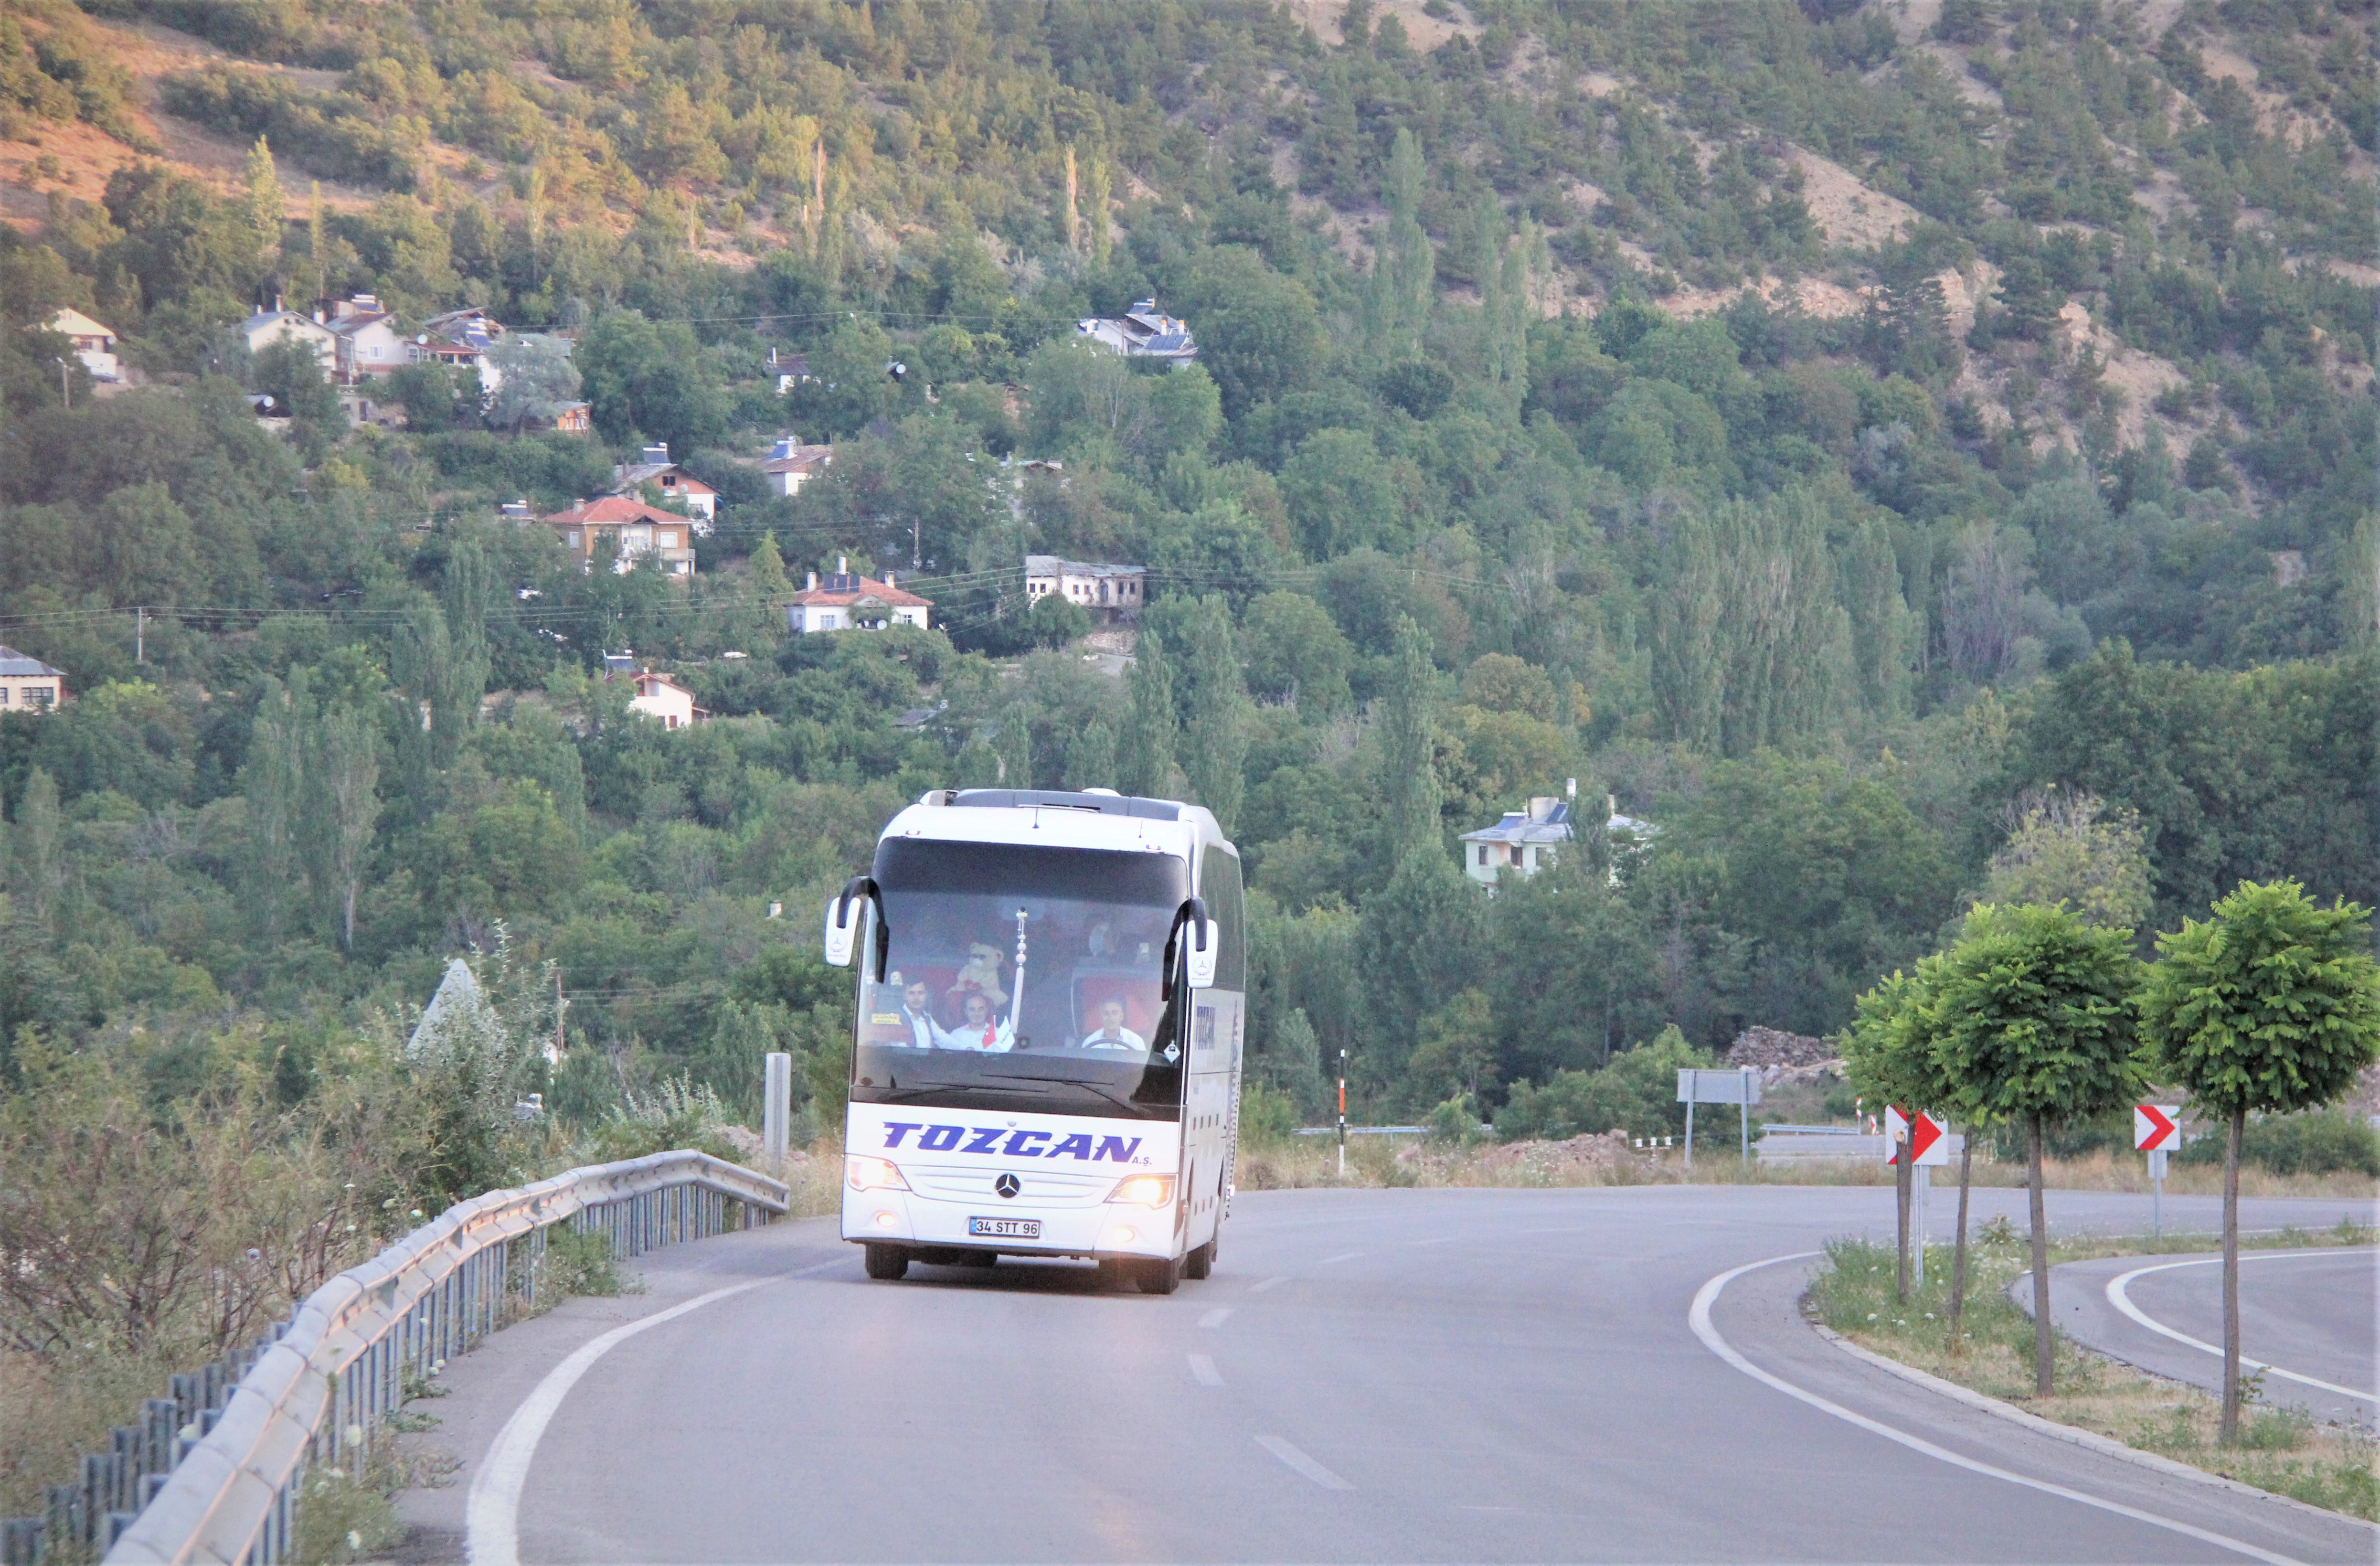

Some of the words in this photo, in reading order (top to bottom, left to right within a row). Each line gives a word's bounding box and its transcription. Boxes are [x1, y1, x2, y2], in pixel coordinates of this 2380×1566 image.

[882, 1121, 1143, 1162] TOZCAN
[1132, 1156, 1152, 1166] A.Ş.
[977, 1221, 991, 1232] 34
[997, 1222, 1018, 1233] STT
[1023, 1224, 1037, 1234] 96
